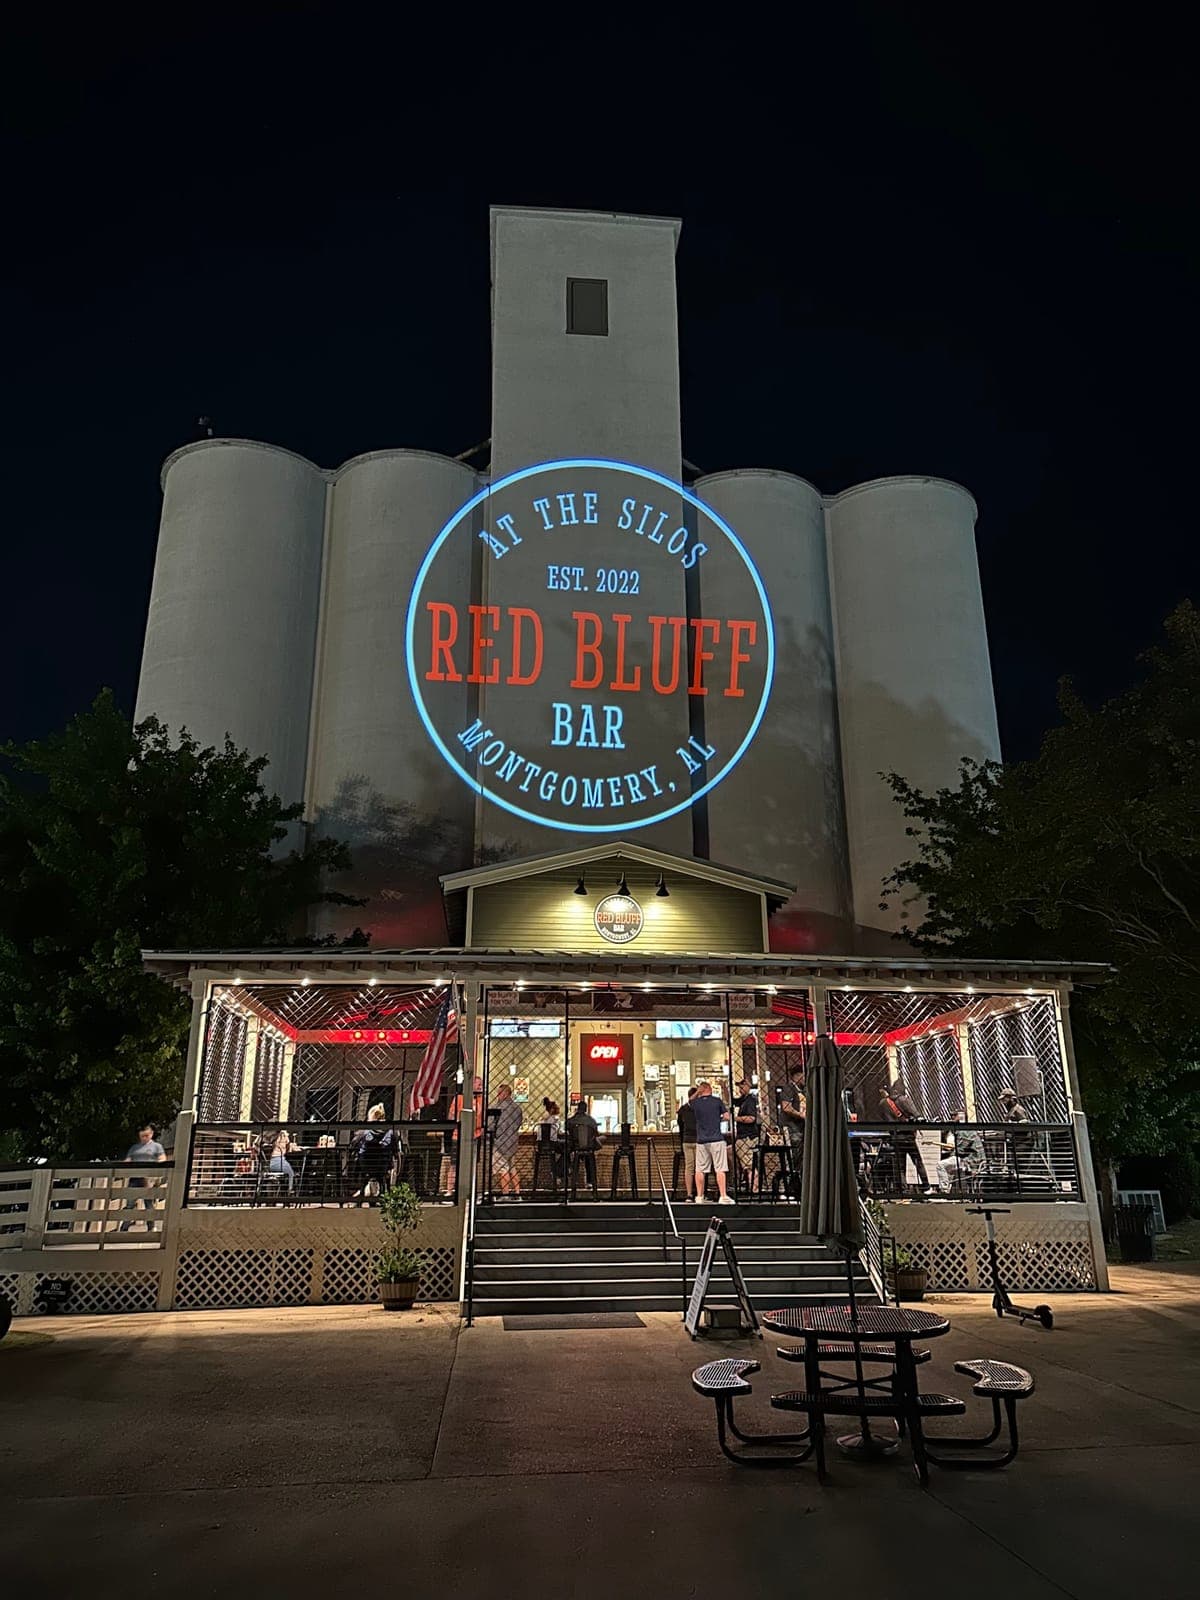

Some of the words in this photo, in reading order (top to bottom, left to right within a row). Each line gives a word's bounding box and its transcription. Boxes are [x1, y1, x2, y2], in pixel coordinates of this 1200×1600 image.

[479, 514, 522, 558] AT
[533, 493, 598, 530] THE
[618, 498, 708, 569] SILOS
[547, 565, 589, 592] EST.
[596, 568, 640, 594] 2022
[425, 601, 544, 686] RED
[570, 610, 757, 697] BLUFF
[551, 702, 626, 749] BAR
[456, 718, 677, 808] MONTGOMERY,
[676, 735, 718, 775] AL
[597, 911, 614, 923] RED
[615, 912, 641, 924] BLUFF
[590, 1045, 619, 1059] OPEN
[50, 1282, 62, 1290] NO
